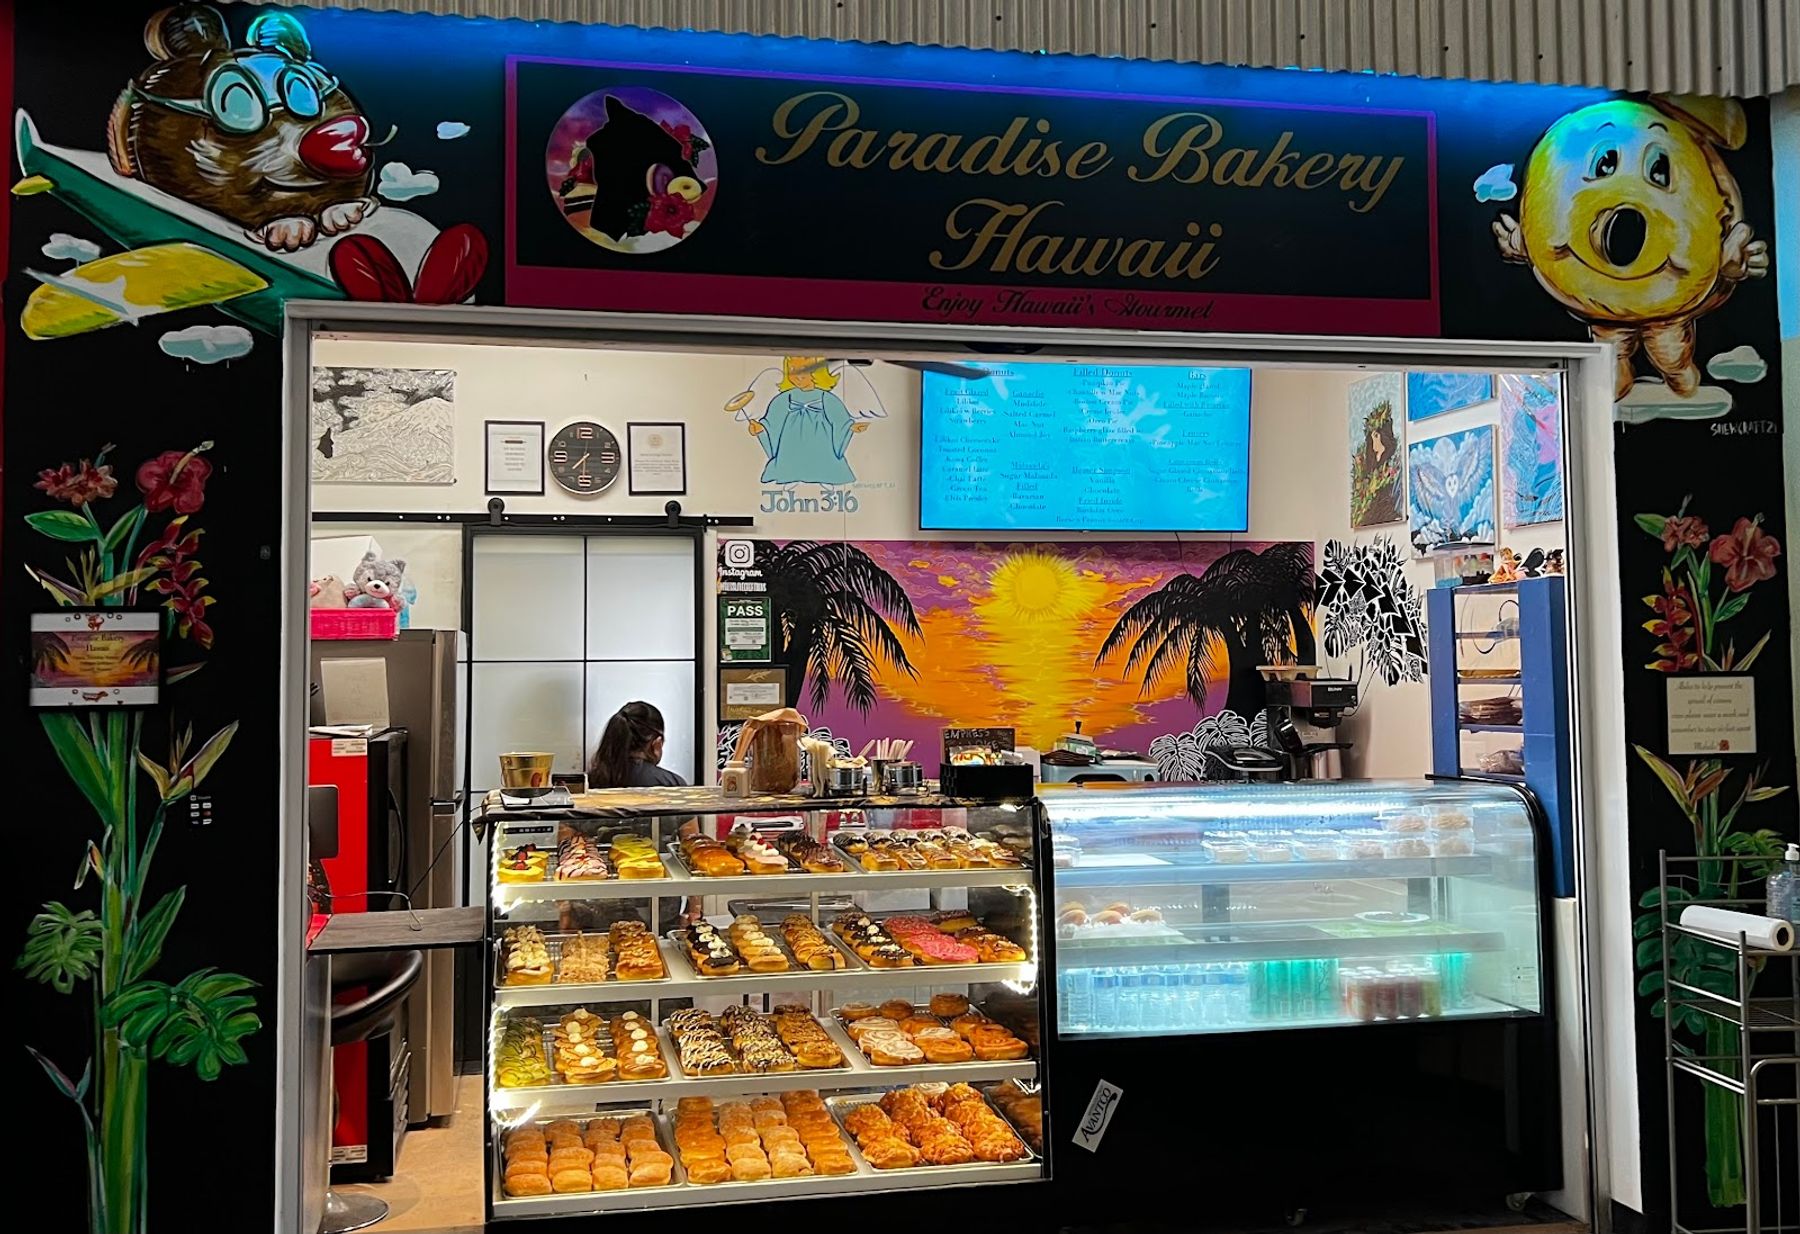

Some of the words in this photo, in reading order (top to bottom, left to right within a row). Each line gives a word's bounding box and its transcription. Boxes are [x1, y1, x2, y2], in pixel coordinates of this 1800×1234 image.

[755, 91, 1114, 180] Paradise
[1127, 112, 1406, 214] Bakery
[928, 198, 1224, 280] Hawaii
[921, 286, 982, 318] Enjoy
[1102, 368, 1133, 377] Donuts
[760, 490, 820, 514] John
[820, 490, 860, 514] 3:16
[718, 567, 764, 582] Instagram
[727, 605, 764, 618] PASS
